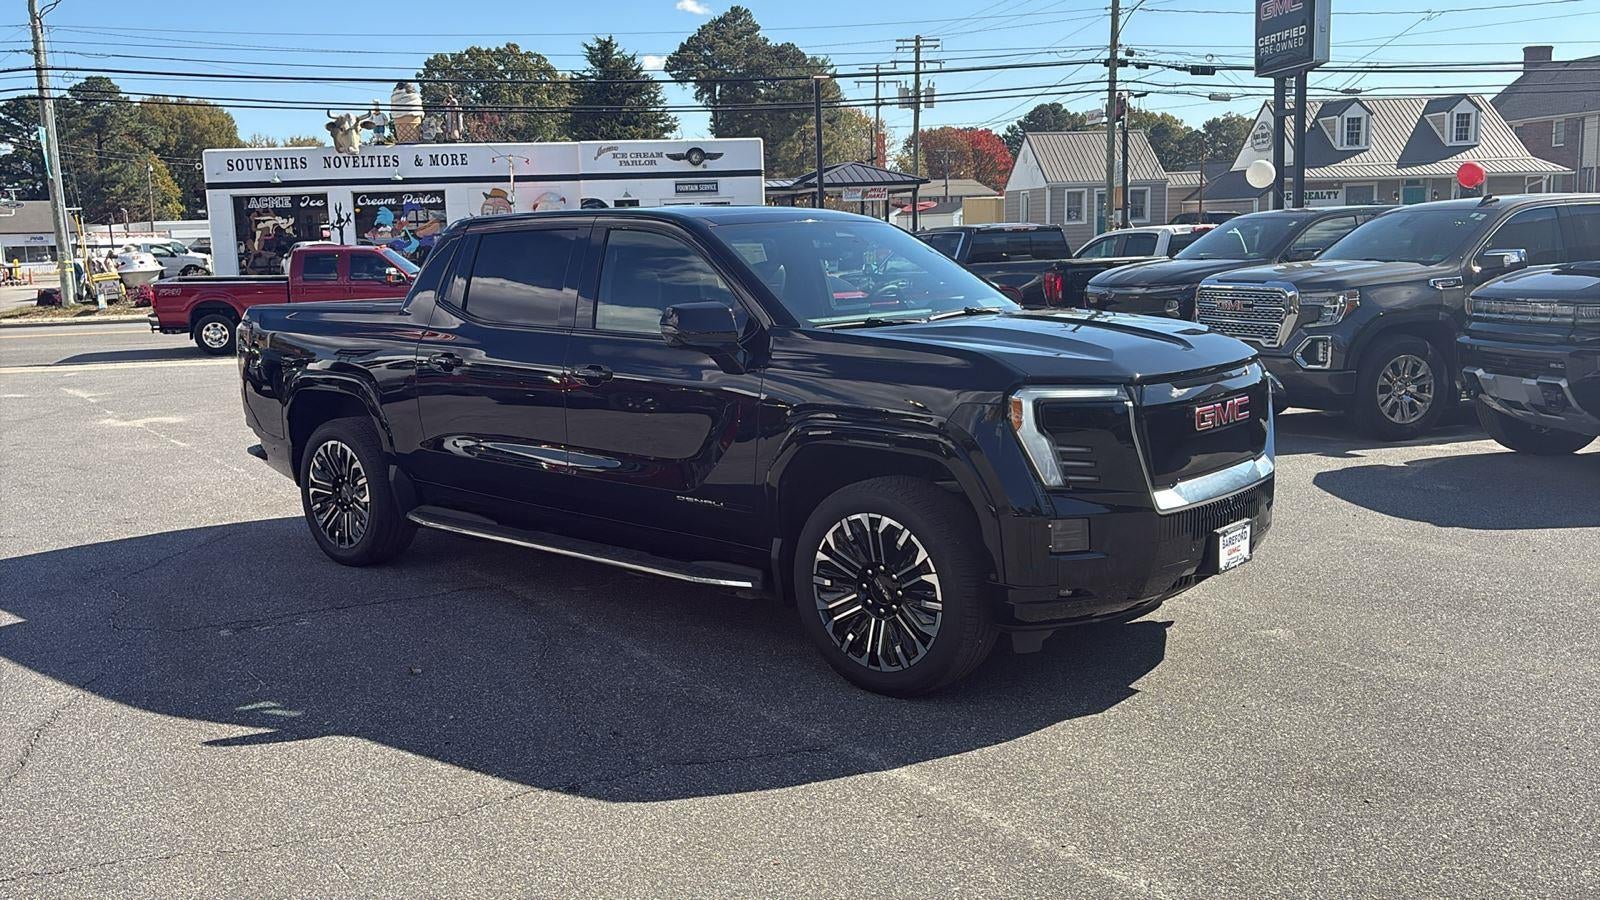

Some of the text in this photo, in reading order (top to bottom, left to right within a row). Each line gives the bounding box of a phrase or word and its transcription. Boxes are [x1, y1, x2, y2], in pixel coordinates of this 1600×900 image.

[1258, 25, 1306, 47] CERTIFIED
[1260, 37, 1303, 56] PRE-OWNED
[226, 153, 468, 172] SOUVENIRS NOVELTIES & MORE
[629, 151, 663, 159] CREAM
[248, 195, 325, 209] ACME Ice
[357, 193, 443, 206] Cream Parlor
[1304, 191, 1339, 200] REALTY
[1195, 396, 1250, 431] GMC
[676, 495, 723, 507] DENALI
[1222, 530, 1248, 549] BAREFORD
